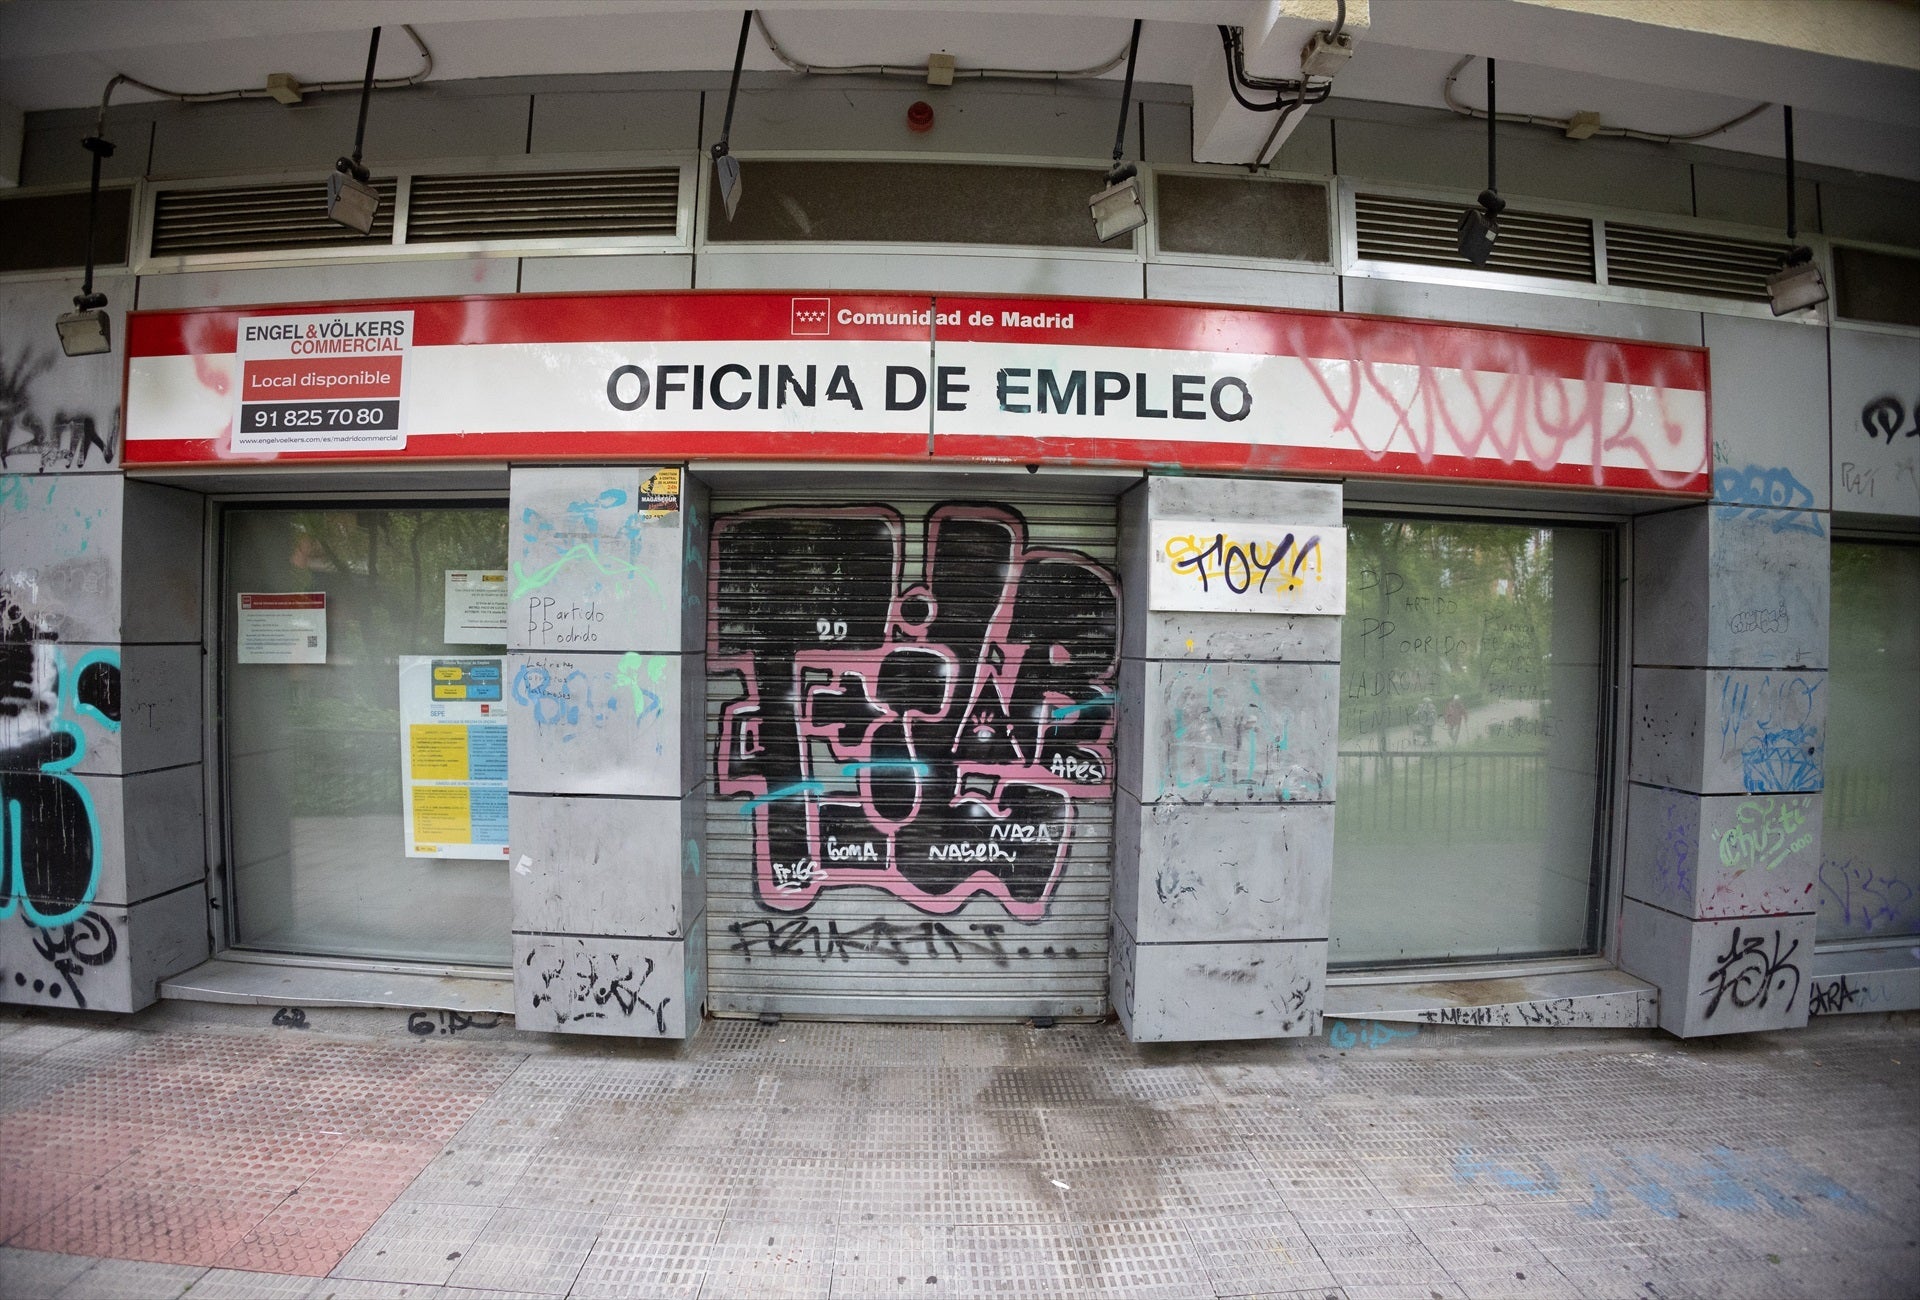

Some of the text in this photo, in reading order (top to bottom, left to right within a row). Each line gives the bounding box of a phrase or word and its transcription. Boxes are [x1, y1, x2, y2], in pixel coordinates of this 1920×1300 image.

[837, 308, 1074, 329] Comunidad de Madrid
[290, 337, 404, 355] COMMERCIAL
[252, 370, 391, 388] Local disponible
[606, 363, 1253, 422] OFICINA DE EMPLEO
[255, 408, 384, 427] 91 825 70 80
[239, 434, 399, 446] www.engelvoelkers.com/es/madridcommercial
